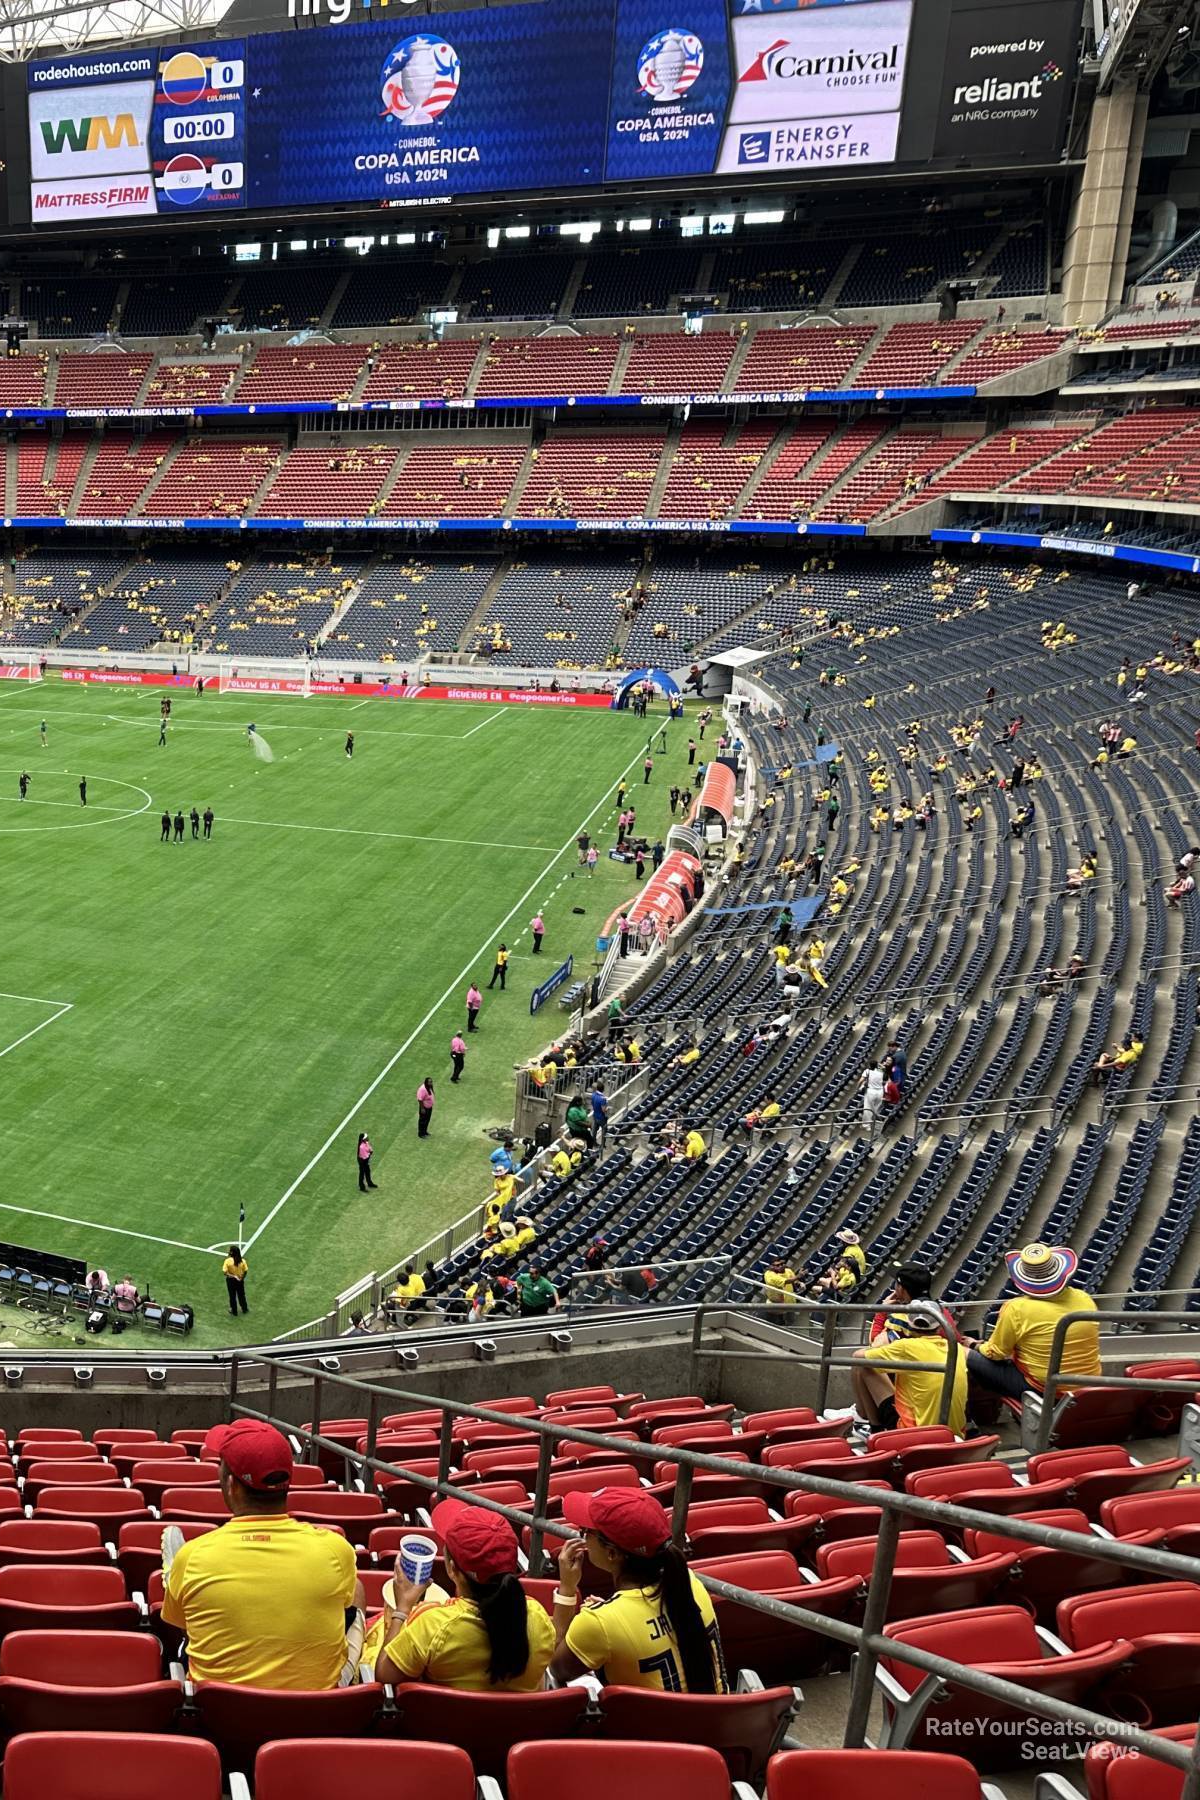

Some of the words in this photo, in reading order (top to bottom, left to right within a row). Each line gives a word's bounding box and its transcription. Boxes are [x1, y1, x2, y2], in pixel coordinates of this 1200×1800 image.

[970, 39, 1027, 58] powered
[1029, 39, 1044, 52] by
[775, 43, 898, 78] Carnival
[34, 58, 150, 81] rodeohouston.com
[222, 66, 233, 83] 0
[826, 74, 871, 87] CHOOSE
[874, 72, 897, 83] FUN
[954, 75, 1042, 104] reliant
[616, 119, 651, 132] COPA
[654, 112, 715, 130] AMERICA
[951, 114, 964, 122] an
[965, 110, 990, 121] NRG
[990, 108, 1039, 119] company
[40, 113, 140, 154] WM
[174, 119, 225, 139] 00:00
[639, 132, 660, 142] USA
[663, 130, 689, 140] 2024
[776, 124, 853, 144] ENERGY
[398, 137, 437, 149] CONMEBOL
[355, 153, 399, 170] COPA
[402, 146, 480, 167] AMERICA
[775, 142, 870, 162] TRANSFER
[222, 169, 232, 185] 0
[385, 171, 410, 184] USA
[415, 168, 448, 182] 2024
[389, 199, 422, 207] MITSUBISHI
[423, 197, 451, 205] ELECTRIC
[641, 395, 693, 404] CONMEBOL
[694, 395, 720, 403] COPA
[720, 394, 762, 403] AMERICA
[763, 394, 781, 402] USA
[782, 393, 805, 402] 2024
[66, 409, 108, 417] CONMEBOL
[129, 408, 161, 416] AMERICA
[104, 519, 124, 527] COPA
[303, 520, 345, 528] CONMEBOL
[346, 520, 367, 528] COPA
[368, 520, 403, 528] AMERICA
[403, 520, 419, 528] USA
[576, 521, 625, 529] CONMEBOL
[626, 521, 650, 529] COPA
[651, 522, 691, 530] AMERICA
[692, 522, 708, 530] USA
[709, 522, 731, 531] 2024
[509, 693, 576, 702] @copaamerica
